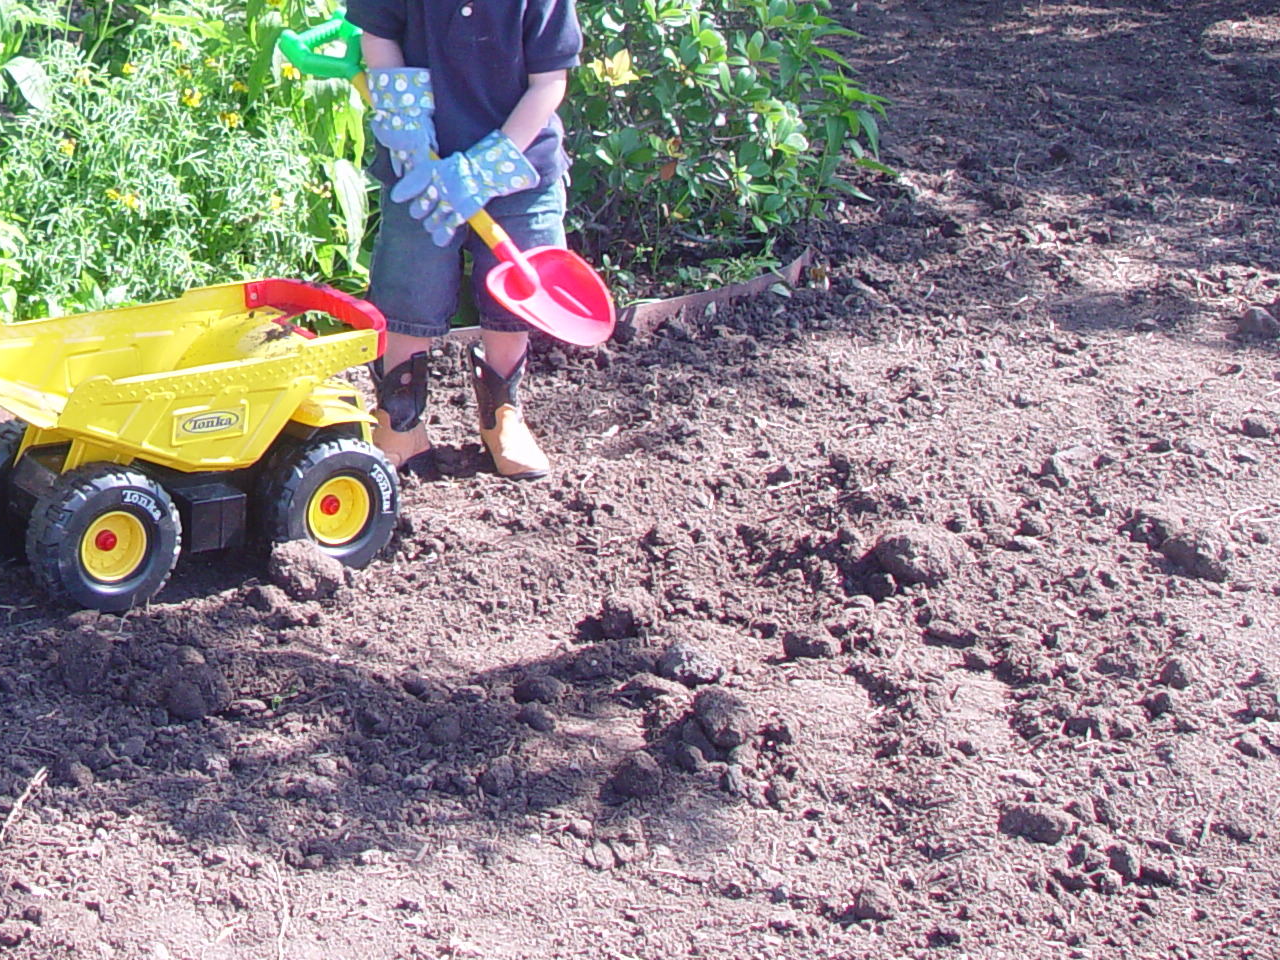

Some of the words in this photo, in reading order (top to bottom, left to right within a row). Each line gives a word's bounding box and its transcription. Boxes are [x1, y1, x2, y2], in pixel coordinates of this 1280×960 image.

[189, 416, 232, 430] Tonka
[370, 464, 392, 511] Tonka
[122, 490, 161, 520] Tonka
